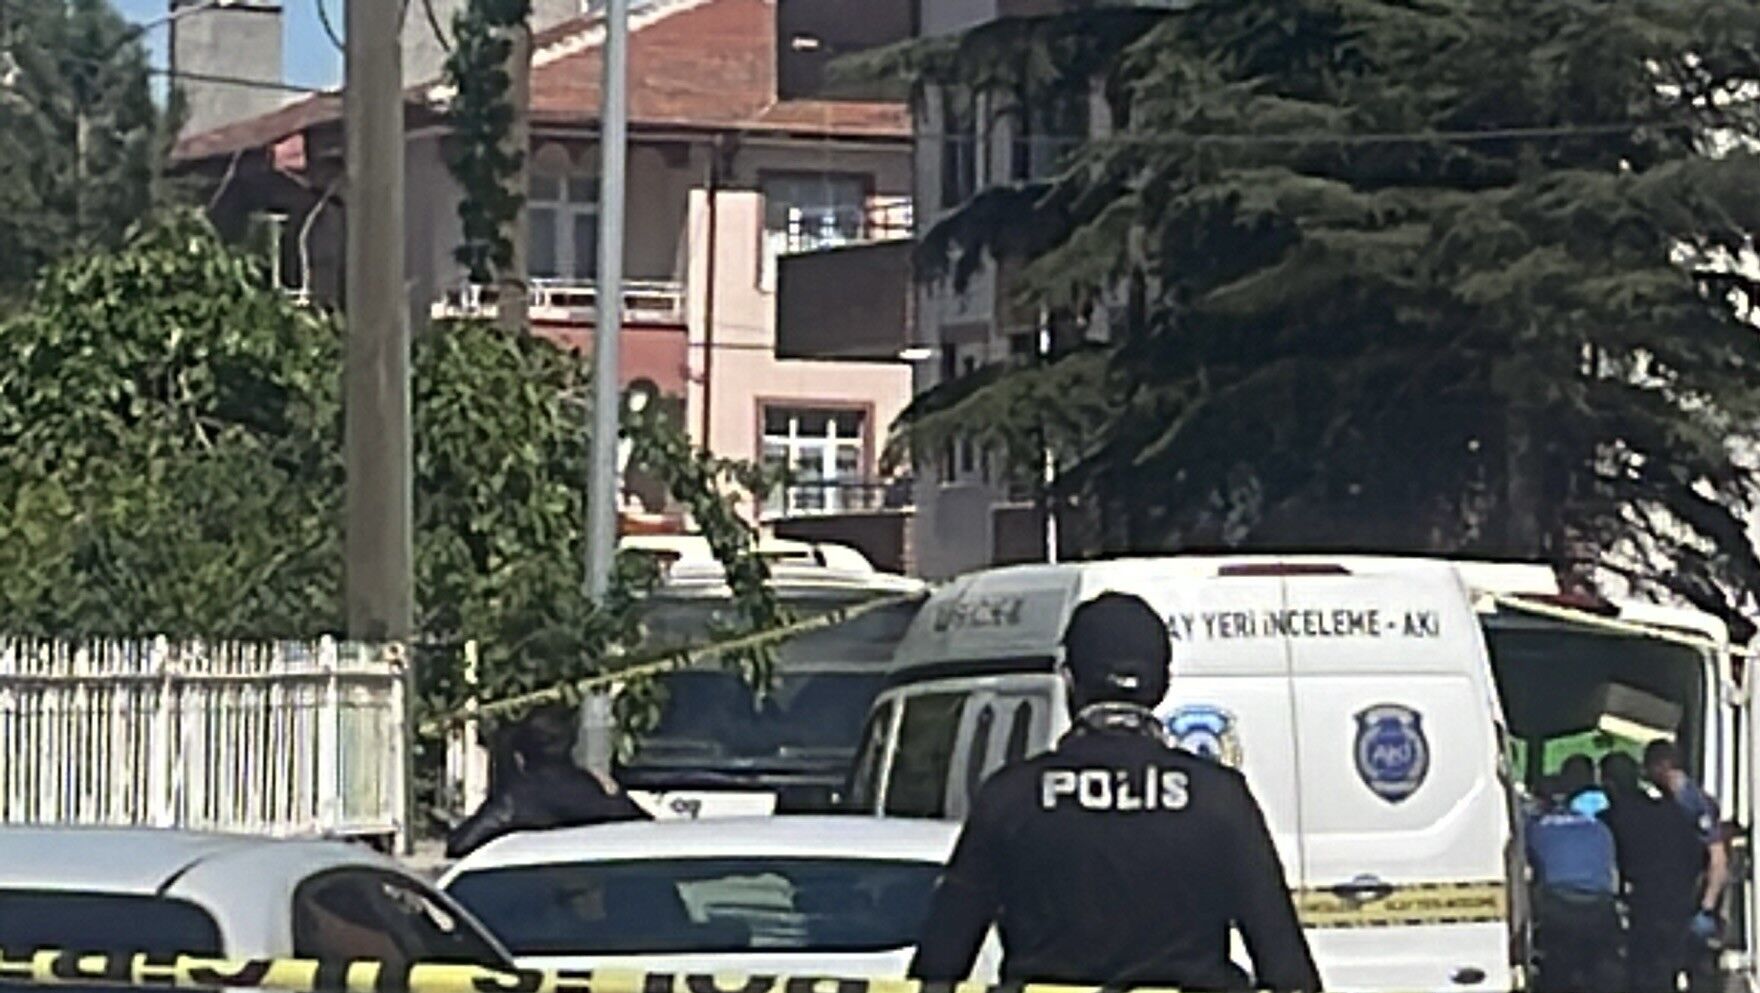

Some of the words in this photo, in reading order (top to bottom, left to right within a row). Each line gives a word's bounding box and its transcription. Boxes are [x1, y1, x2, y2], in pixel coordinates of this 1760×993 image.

[1167, 613, 1195, 641] AY
[1202, 611, 1255, 639] YERİ
[1263, 609, 1380, 638] İNCELEME
